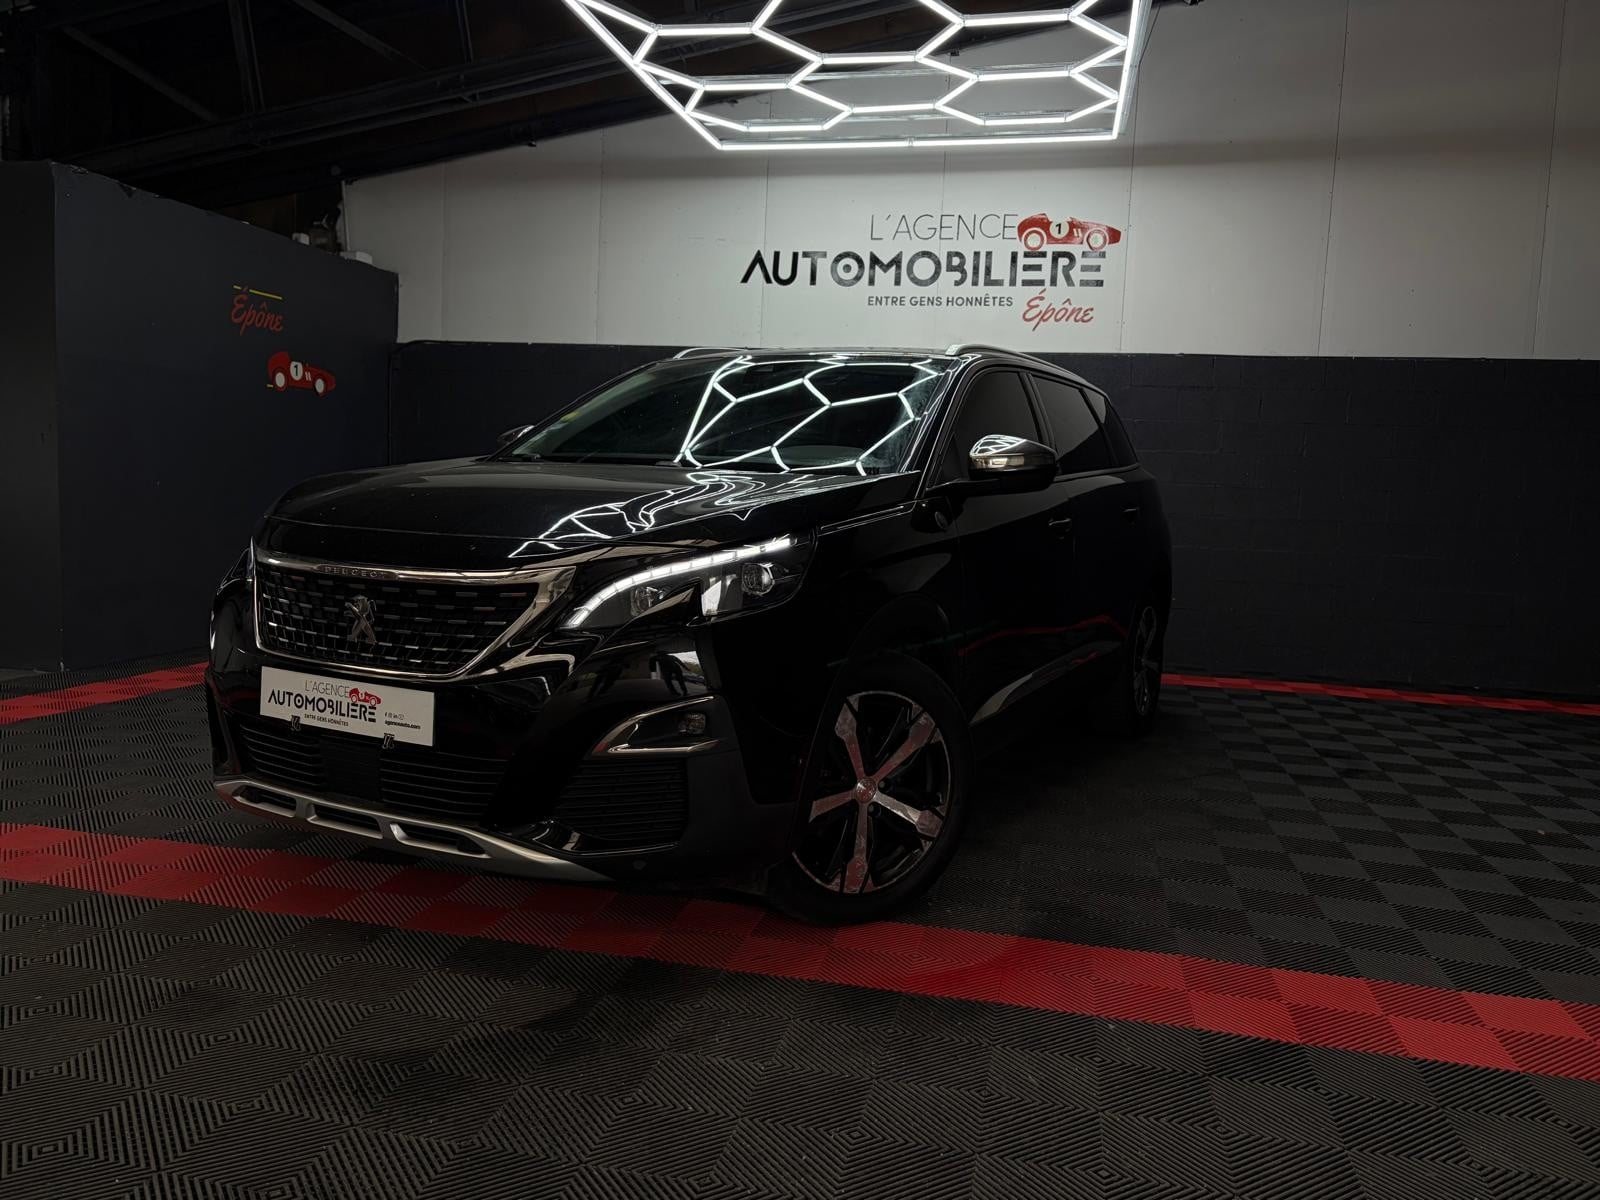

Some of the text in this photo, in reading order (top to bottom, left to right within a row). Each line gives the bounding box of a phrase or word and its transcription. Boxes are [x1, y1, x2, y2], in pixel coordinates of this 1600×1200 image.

[870, 213, 1019, 241] L'AGENCE
[1055, 222, 1062, 233] 1
[867, 293, 1014, 307] ENTRE GENS HONNÊTES
[1022, 287, 1094, 332] Épône
[231, 285, 284, 337] Épône
[293, 364, 299, 377] 1
[305, 680, 350, 700] L'AGENCE
